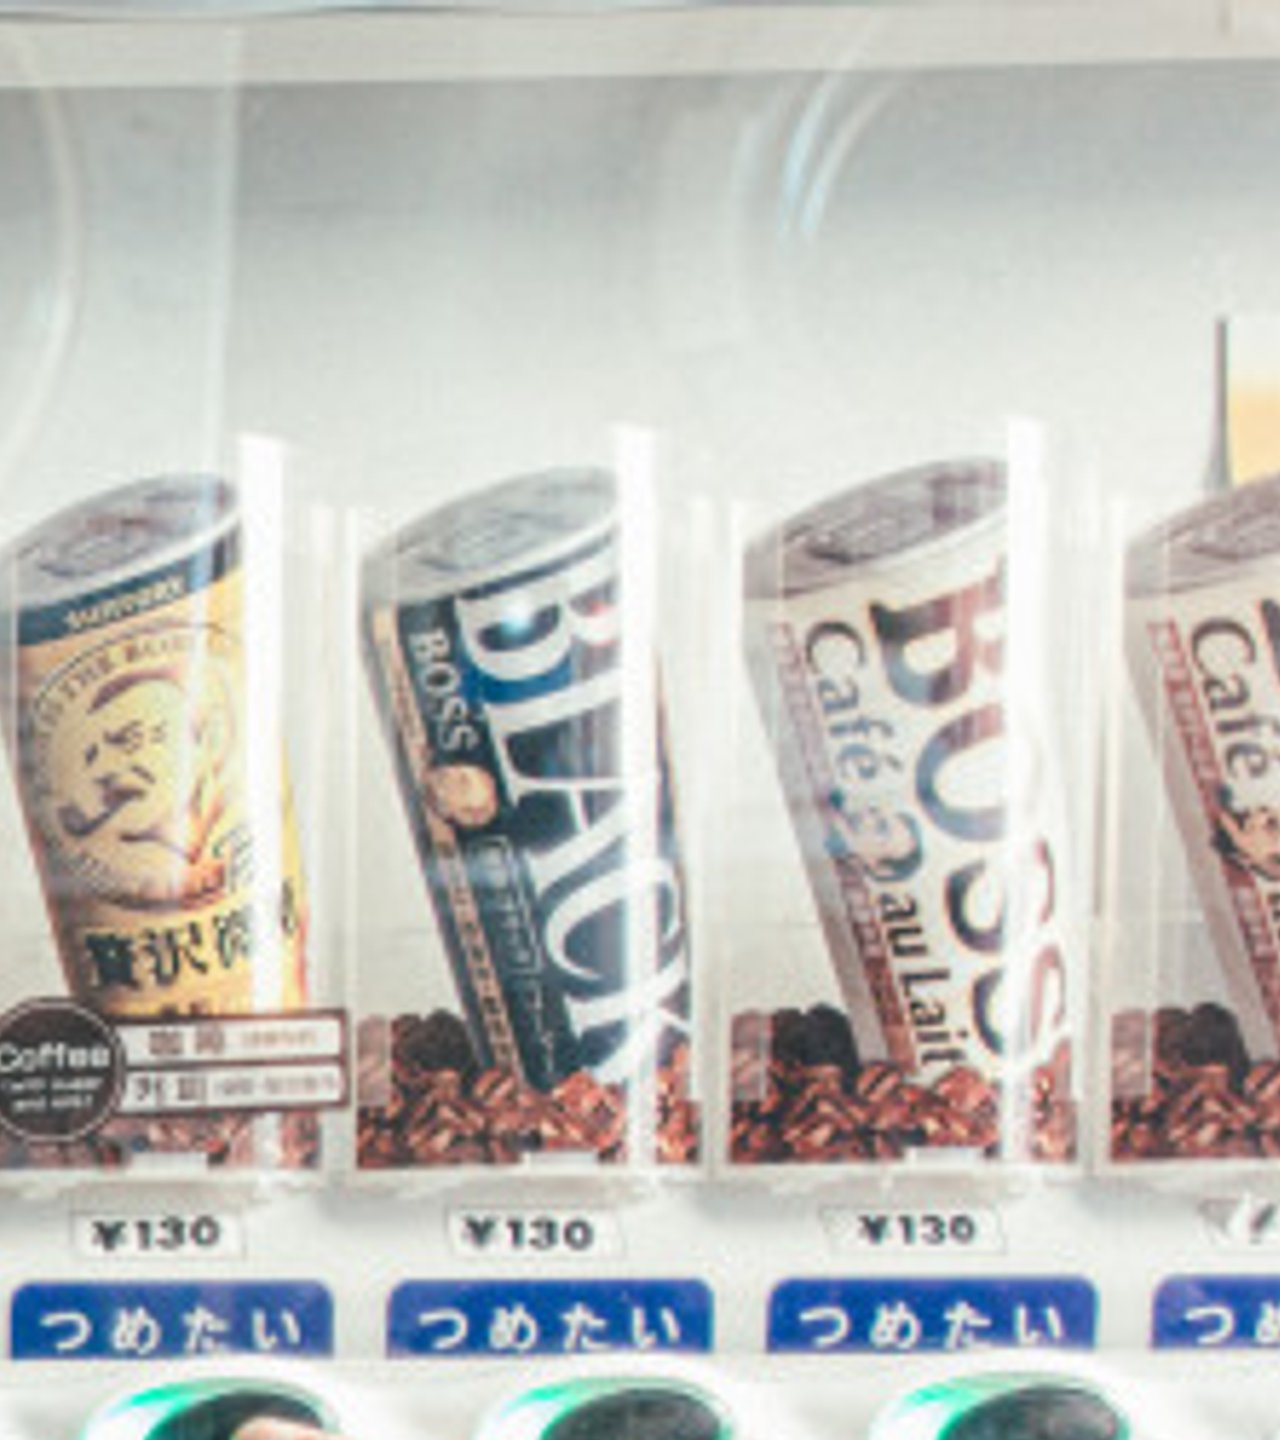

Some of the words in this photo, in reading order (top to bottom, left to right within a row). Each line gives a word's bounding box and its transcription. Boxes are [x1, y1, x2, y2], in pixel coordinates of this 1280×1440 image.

[413, 627, 481, 753] BOSS
[91, 1216, 221, 1251] ¥130
[462, 1216, 594, 1251] ¥130
[858, 1214, 977, 1245] ¥130
[41, 1306, 301, 1356] つめたい
[418, 1303, 681, 1353] つめたい
[798, 1300, 1065, 1350] つめたい
